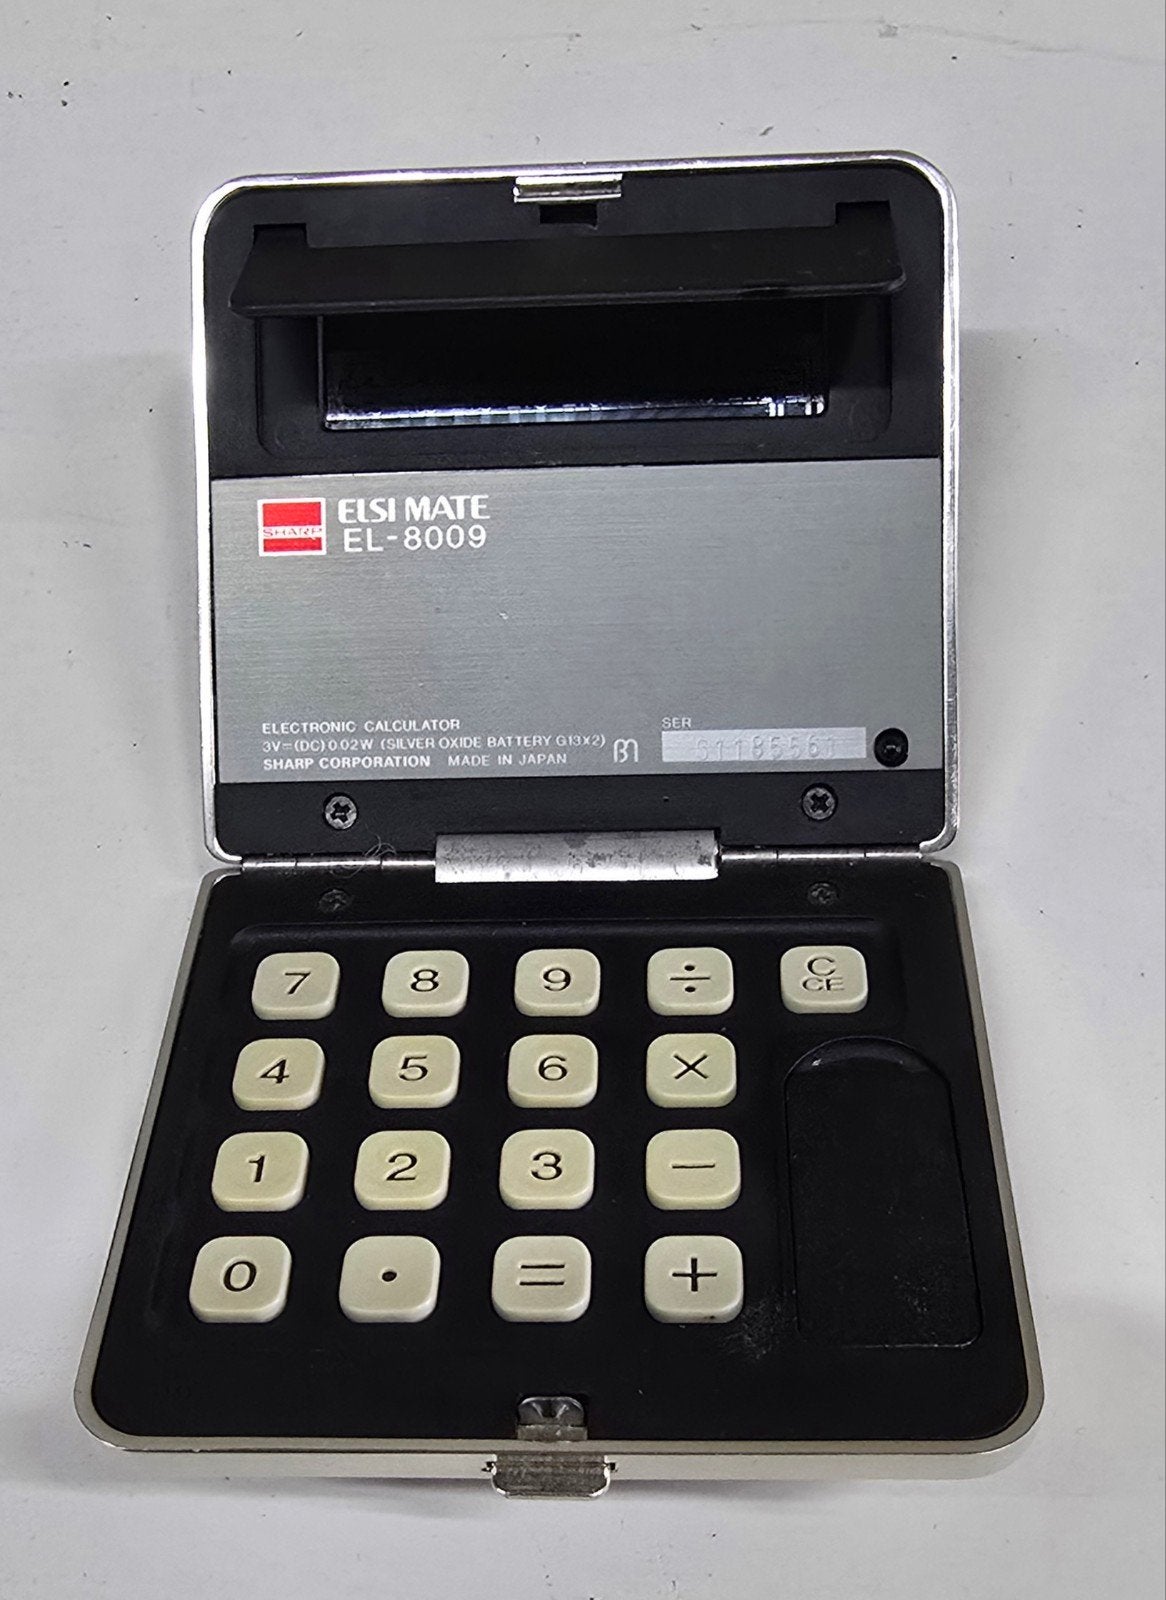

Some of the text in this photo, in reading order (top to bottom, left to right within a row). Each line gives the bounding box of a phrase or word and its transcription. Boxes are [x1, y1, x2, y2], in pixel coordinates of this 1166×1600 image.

[338, 494, 490, 523] ELSI MATE
[263, 528, 322, 537] SHARP
[343, 524, 487, 552] EL-8009
[262, 719, 460, 734] ELECTRONIC CALCULATOR
[662, 717, 692, 728] SER
[380, 738, 435, 750] (SILVER
[438, 736, 482, 749] OXIDE
[487, 735, 551, 748] BATTERY
[263, 755, 431, 770] SHARP CORPORATION
[448, 753, 567, 767] MADE IN JAPAN
[806, 956, 837, 977] C
[284, 971, 311, 995] 7
[410, 968, 440, 993] 8
[542, 967, 572, 992] 9
[801, 977, 845, 992] CE
[259, 1059, 290, 1085] 4
[399, 1055, 429, 1082] 5
[538, 1055, 568, 1082] 6
[248, 1155, 266, 1183] 1
[385, 1152, 418, 1182] 2
[531, 1151, 563, 1181] 3
[223, 1260, 258, 1293] 0
[519, 1263, 566, 1287] =
[671, 1257, 718, 1293] +
